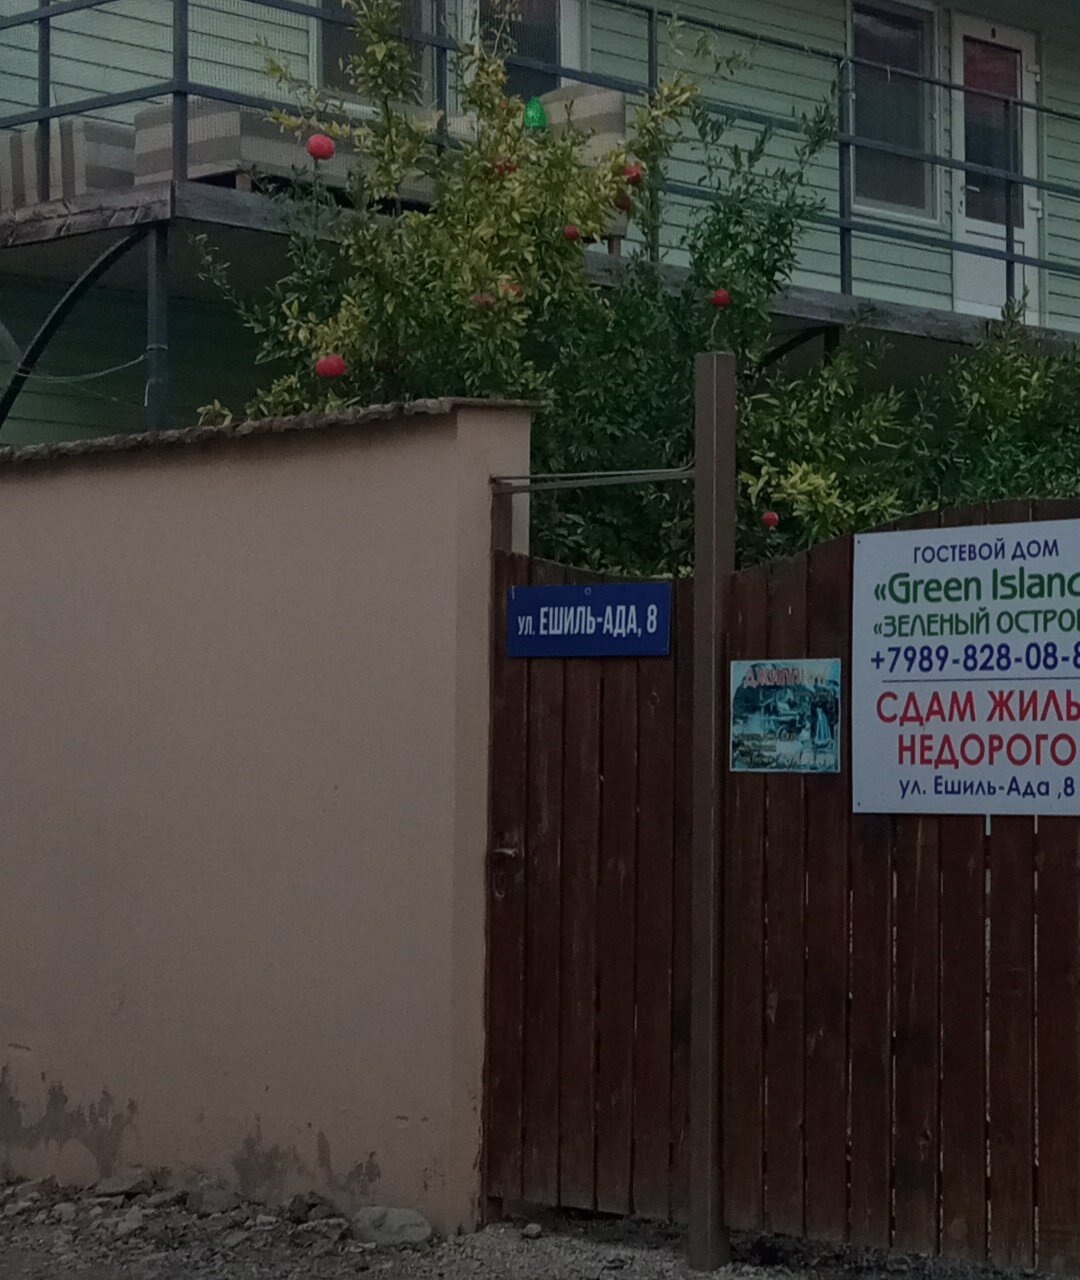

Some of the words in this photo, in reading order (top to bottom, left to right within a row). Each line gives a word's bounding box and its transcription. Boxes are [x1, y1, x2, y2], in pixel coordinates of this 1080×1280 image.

[914, 539, 1005, 563] ГОСТЕВОЙ
[1011, 539, 1059, 560] ДОМ
[874, 572, 981, 604] «Green
[539, 605, 642, 638] ЕШИЛЬ-АДА,
[647, 604, 657, 633] 8
[873, 607, 990, 638] «ЗЕЛЕНЫЙ
[876, 691, 976, 726] СДАМ
[898, 733, 1077, 769] НЕДОРОГО
[899, 779, 926, 798] ул.
[934, 776, 1050, 797] Ешиль-Ада
